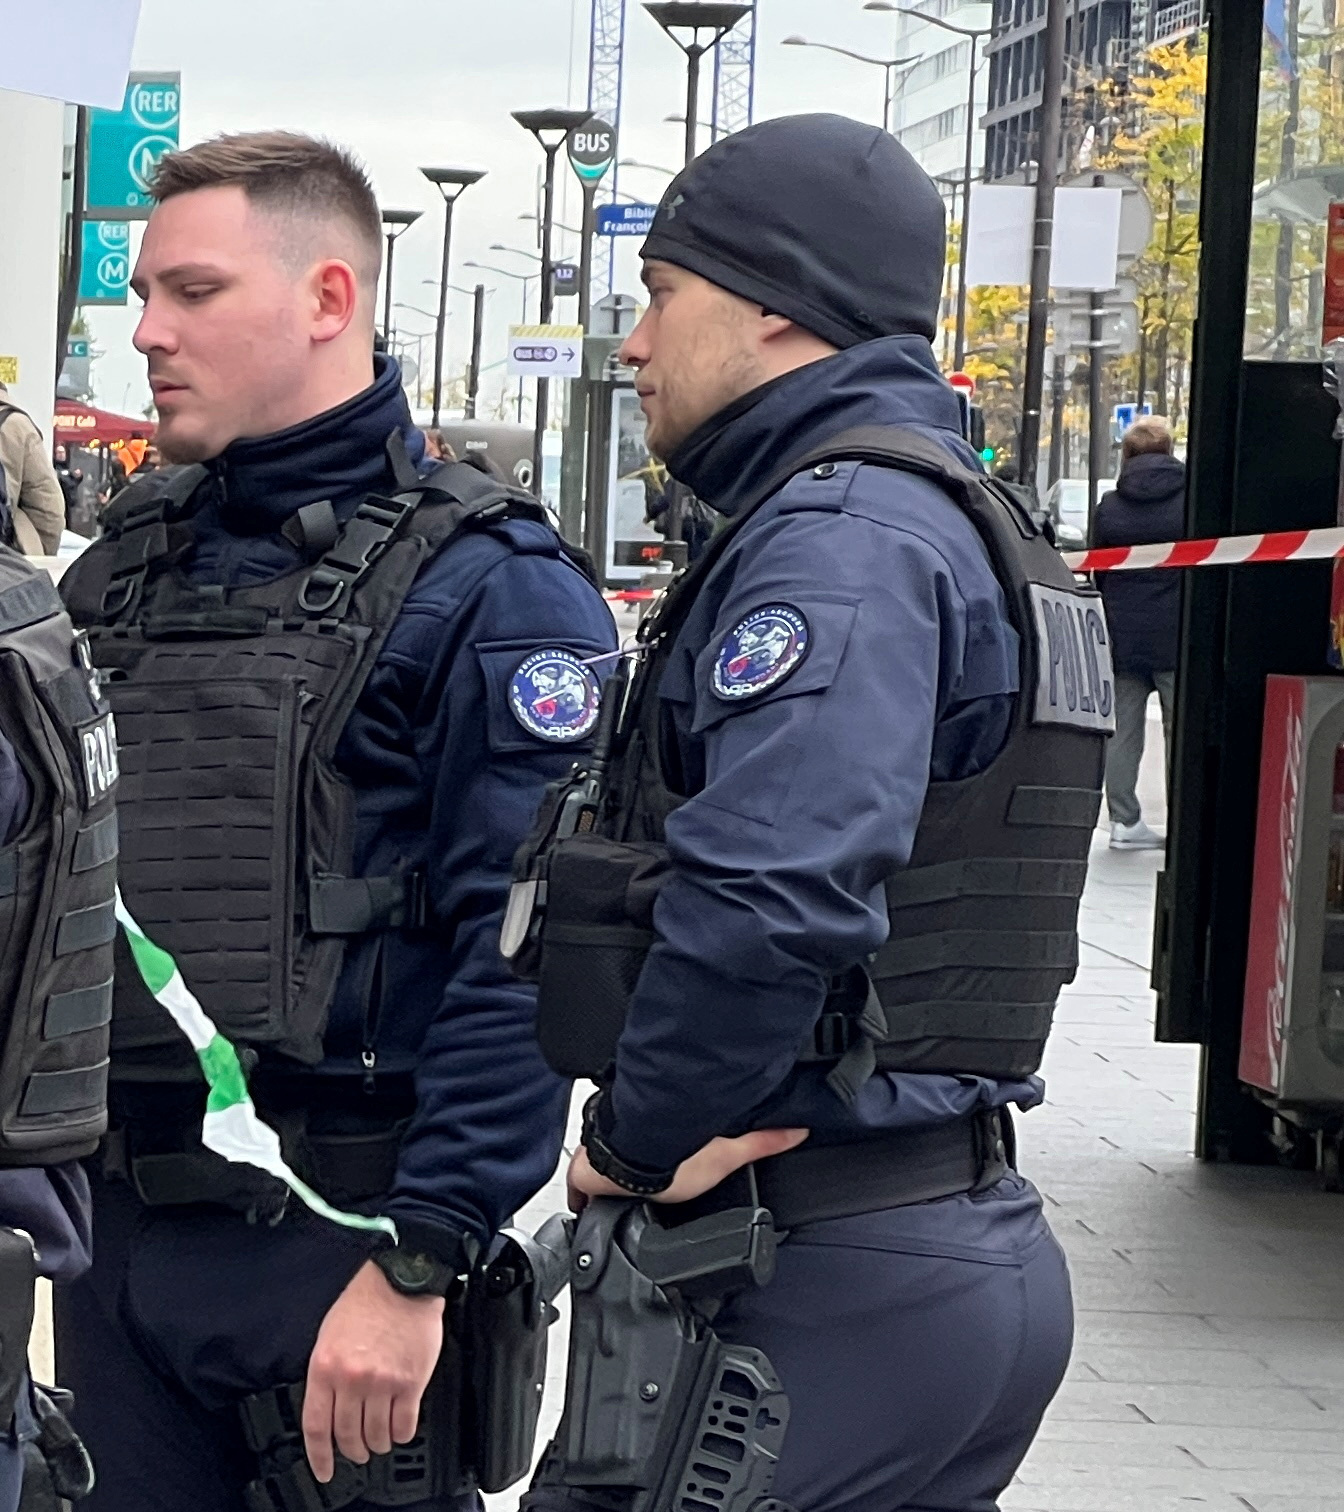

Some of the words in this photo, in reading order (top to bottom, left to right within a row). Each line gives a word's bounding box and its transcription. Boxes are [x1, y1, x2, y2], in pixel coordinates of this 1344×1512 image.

[138, 91, 177, 112] RER
[574, 133, 610, 152] BUS
[604, 221, 652, 234] Françoi
[104, 265, 125, 281] M
[1041, 598, 1112, 718] POLIC
[83, 712, 119, 797] POL
